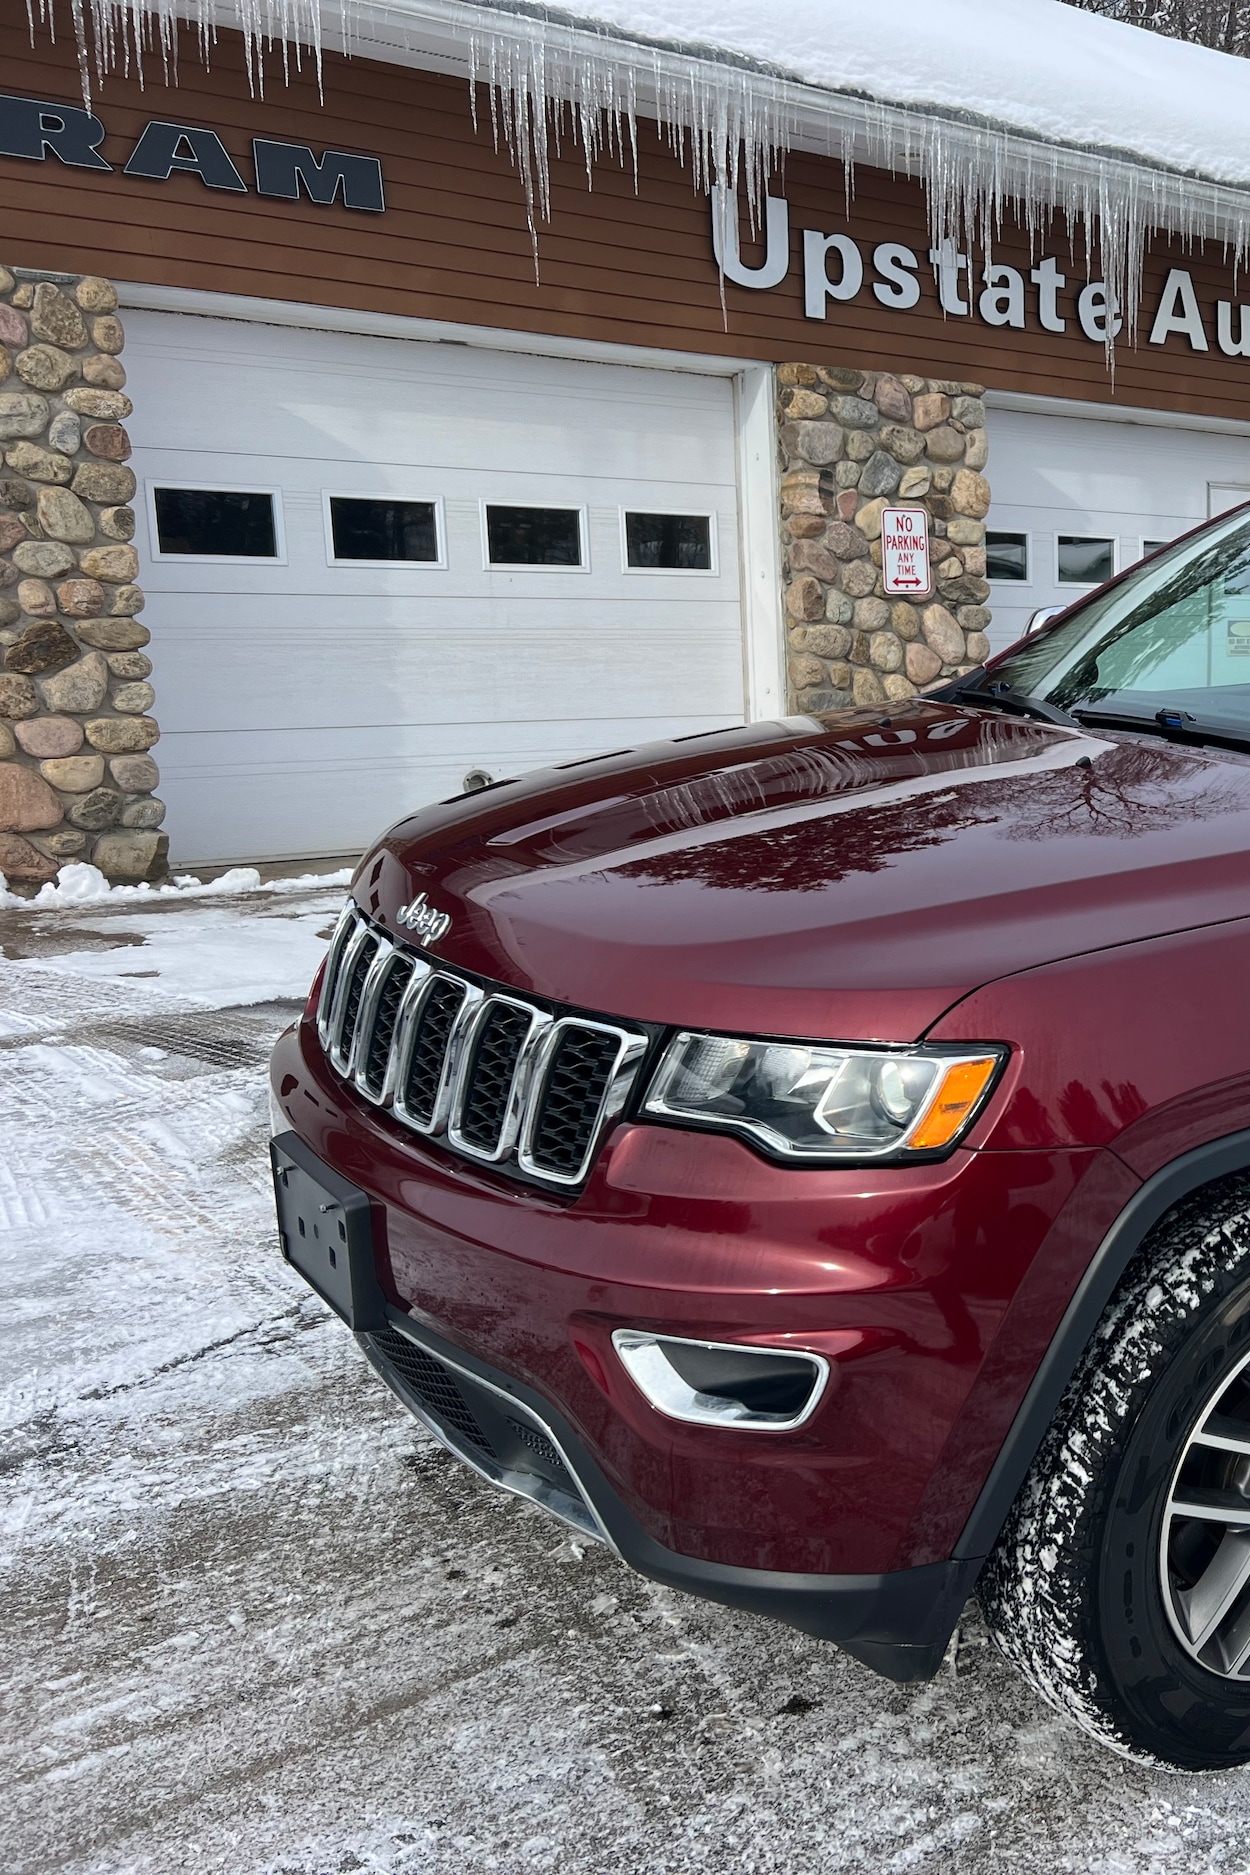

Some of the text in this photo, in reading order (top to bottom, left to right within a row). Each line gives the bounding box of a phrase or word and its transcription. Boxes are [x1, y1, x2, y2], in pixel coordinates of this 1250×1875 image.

[0, 93, 387, 213] RAM
[710, 184, 1123, 343] Upstate
[896, 516, 913, 532] NO
[886, 535, 925, 551] PARKING
[897, 552, 915, 563] ANY
[897, 565, 917, 576] TIME
[396, 892, 452, 947] Jeep
